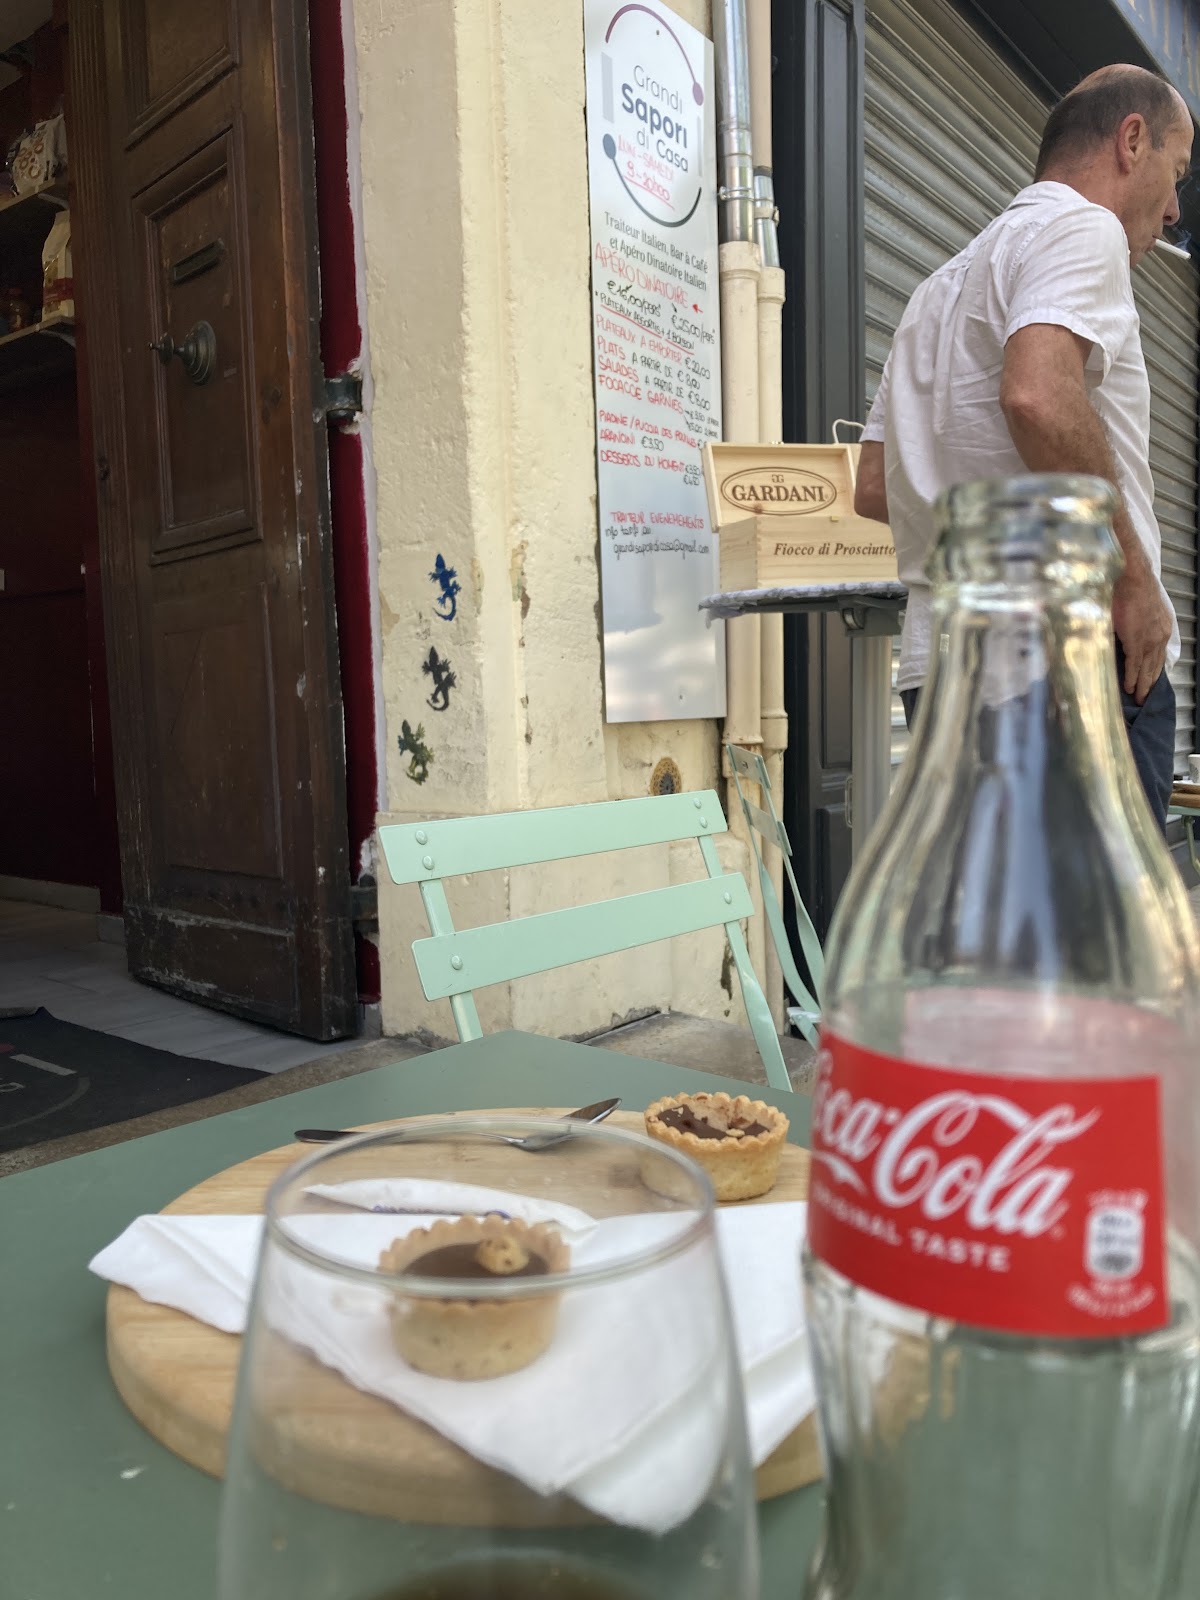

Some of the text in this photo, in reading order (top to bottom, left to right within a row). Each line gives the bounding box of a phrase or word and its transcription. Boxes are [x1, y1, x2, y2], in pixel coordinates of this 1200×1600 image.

[634, 65, 683, 114] Grandi
[621, 83, 688, 149] Sapori
[637, 127, 689, 173] di Casa
[604, 211, 640, 240] Traiteur
[669, 243, 684, 261] Bar
[685, 251, 691, 266] à
[691, 255, 709, 274] Café
[609, 237, 707, 291] et Apéro Dinatoire Italien
[596, 314, 636, 344] PLATEAUX
[597, 335, 626, 361] PLATS
[664, 365, 673, 379] DE
[598, 354, 639, 383] SALADES
[598, 374, 684, 415] FOCACCE GARNIES
[600, 449, 641, 467] DESSERTS
[644, 455, 655, 467] DU
[731, 484, 826, 503] GARDANI
[773, 542, 896, 556] Fiocco di Prosciutto
[909, 1226, 1012, 1275] TASTE
